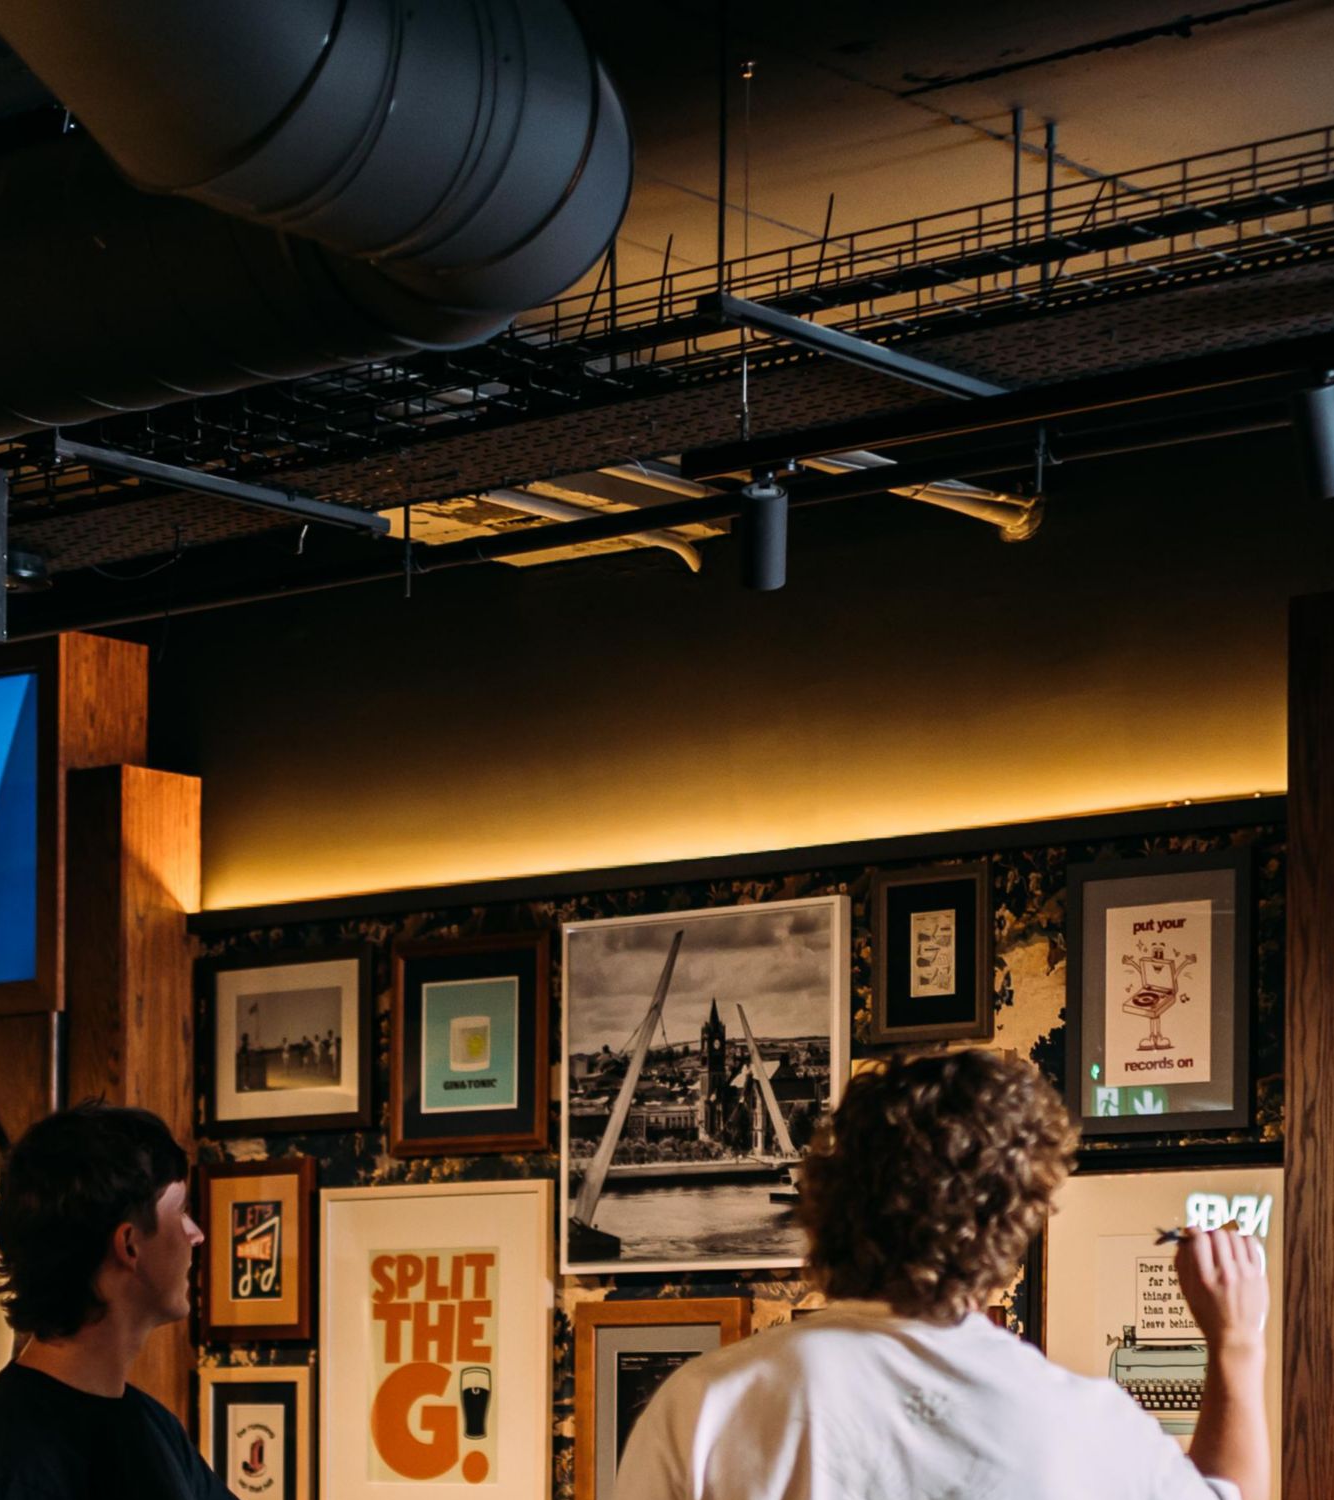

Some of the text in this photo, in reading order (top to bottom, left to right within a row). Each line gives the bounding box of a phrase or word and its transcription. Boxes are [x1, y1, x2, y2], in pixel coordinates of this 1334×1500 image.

[1133, 917, 1186, 935] put your
[1124, 1056, 1194, 1072] records on
[1139, 1263, 1164, 1273] There
[371, 1253, 495, 1304] SPLIT
[1148, 1277, 1164, 1287] far
[1143, 1292, 1172, 1302] things
[1144, 1305, 1185, 1317] than any
[1141, 1319, 1166, 1329] leave
[372, 1300, 492, 1364] THE
